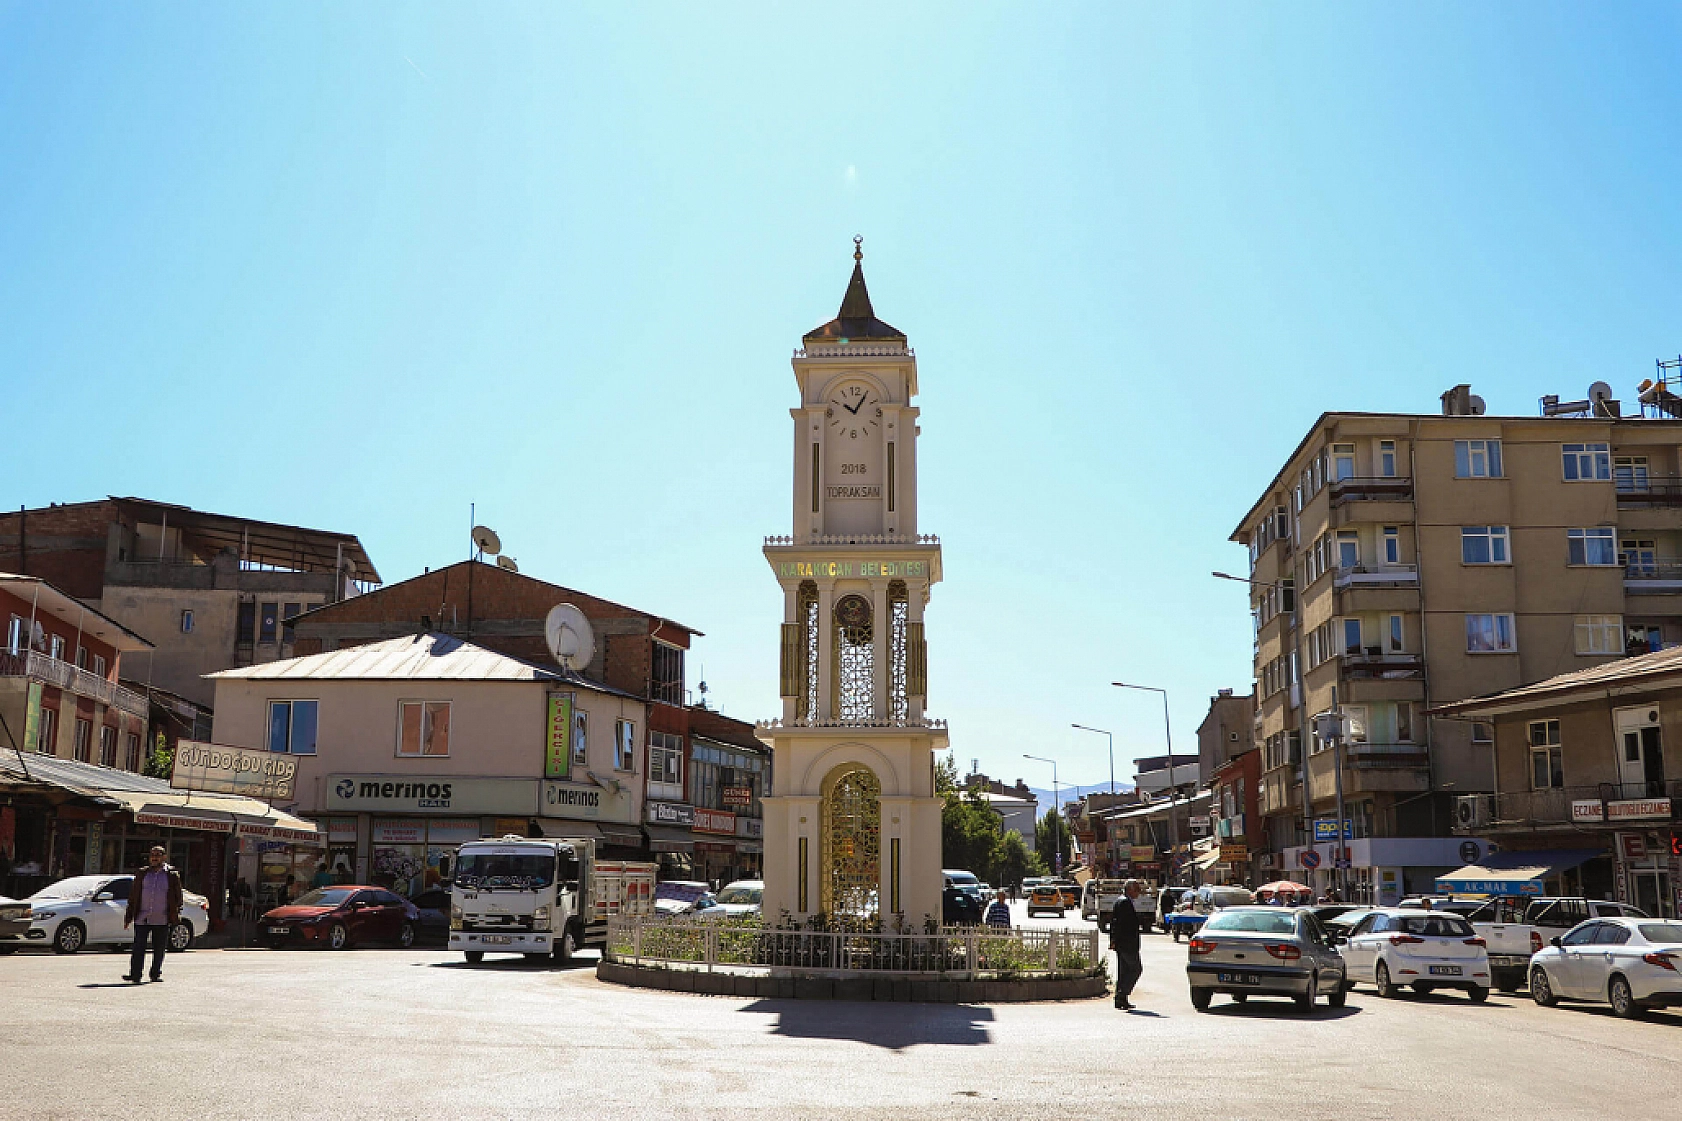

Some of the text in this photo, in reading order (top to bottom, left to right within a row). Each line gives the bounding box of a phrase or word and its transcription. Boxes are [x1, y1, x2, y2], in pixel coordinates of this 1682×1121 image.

[850, 387, 861, 396] 12
[850, 430, 857, 438] 6
[841, 463, 867, 474] 2018
[360, 782, 452, 799] merinos
[558, 788, 599, 808] merinos
[1573, 805, 1603, 818] ECZANE
[1624, 836, 1645, 857] E
[1464, 881, 1508, 892] AK-MAR
